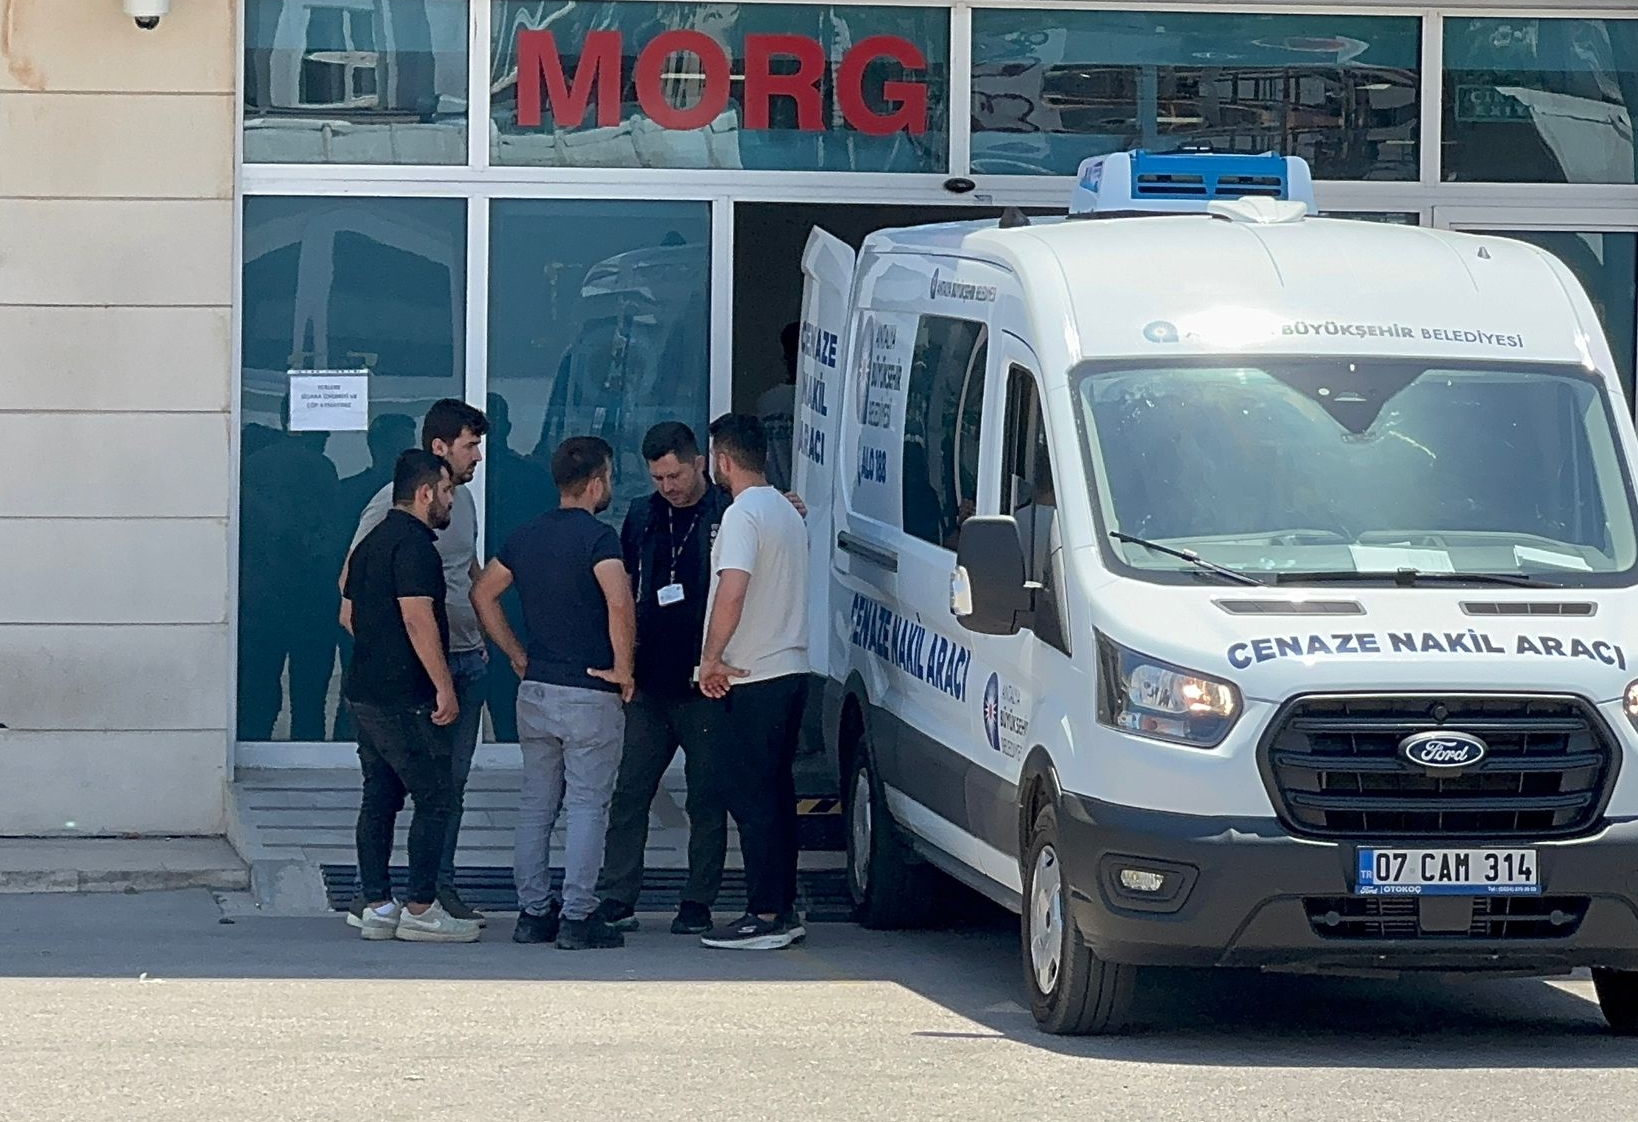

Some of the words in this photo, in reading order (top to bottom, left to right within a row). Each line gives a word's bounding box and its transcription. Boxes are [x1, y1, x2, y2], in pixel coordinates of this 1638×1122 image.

[517, 29, 928, 136] MORG
[801, 319, 838, 368] CENAZE
[1281, 321, 1415, 338] BÜYÜKŞEHİR
[1421, 327, 1524, 348] BELEDİYESİ
[851, 592, 892, 662] CENAZE
[891, 611, 926, 681] NAKİL
[926, 633, 971, 703] ARACI
[1227, 633, 1380, 669] CENAZE
[1388, 628, 1505, 653] NAKİL
[1516, 634, 1626, 670] ARACI
[1421, 741, 1468, 761] Ford
[1360, 870, 1373, 879] TR
[1376, 853, 1408, 881] 07
[1421, 853, 1470, 882] CAM
[1484, 853, 1533, 882] 314
[1383, 885, 1422, 894] OTOKOÇ
